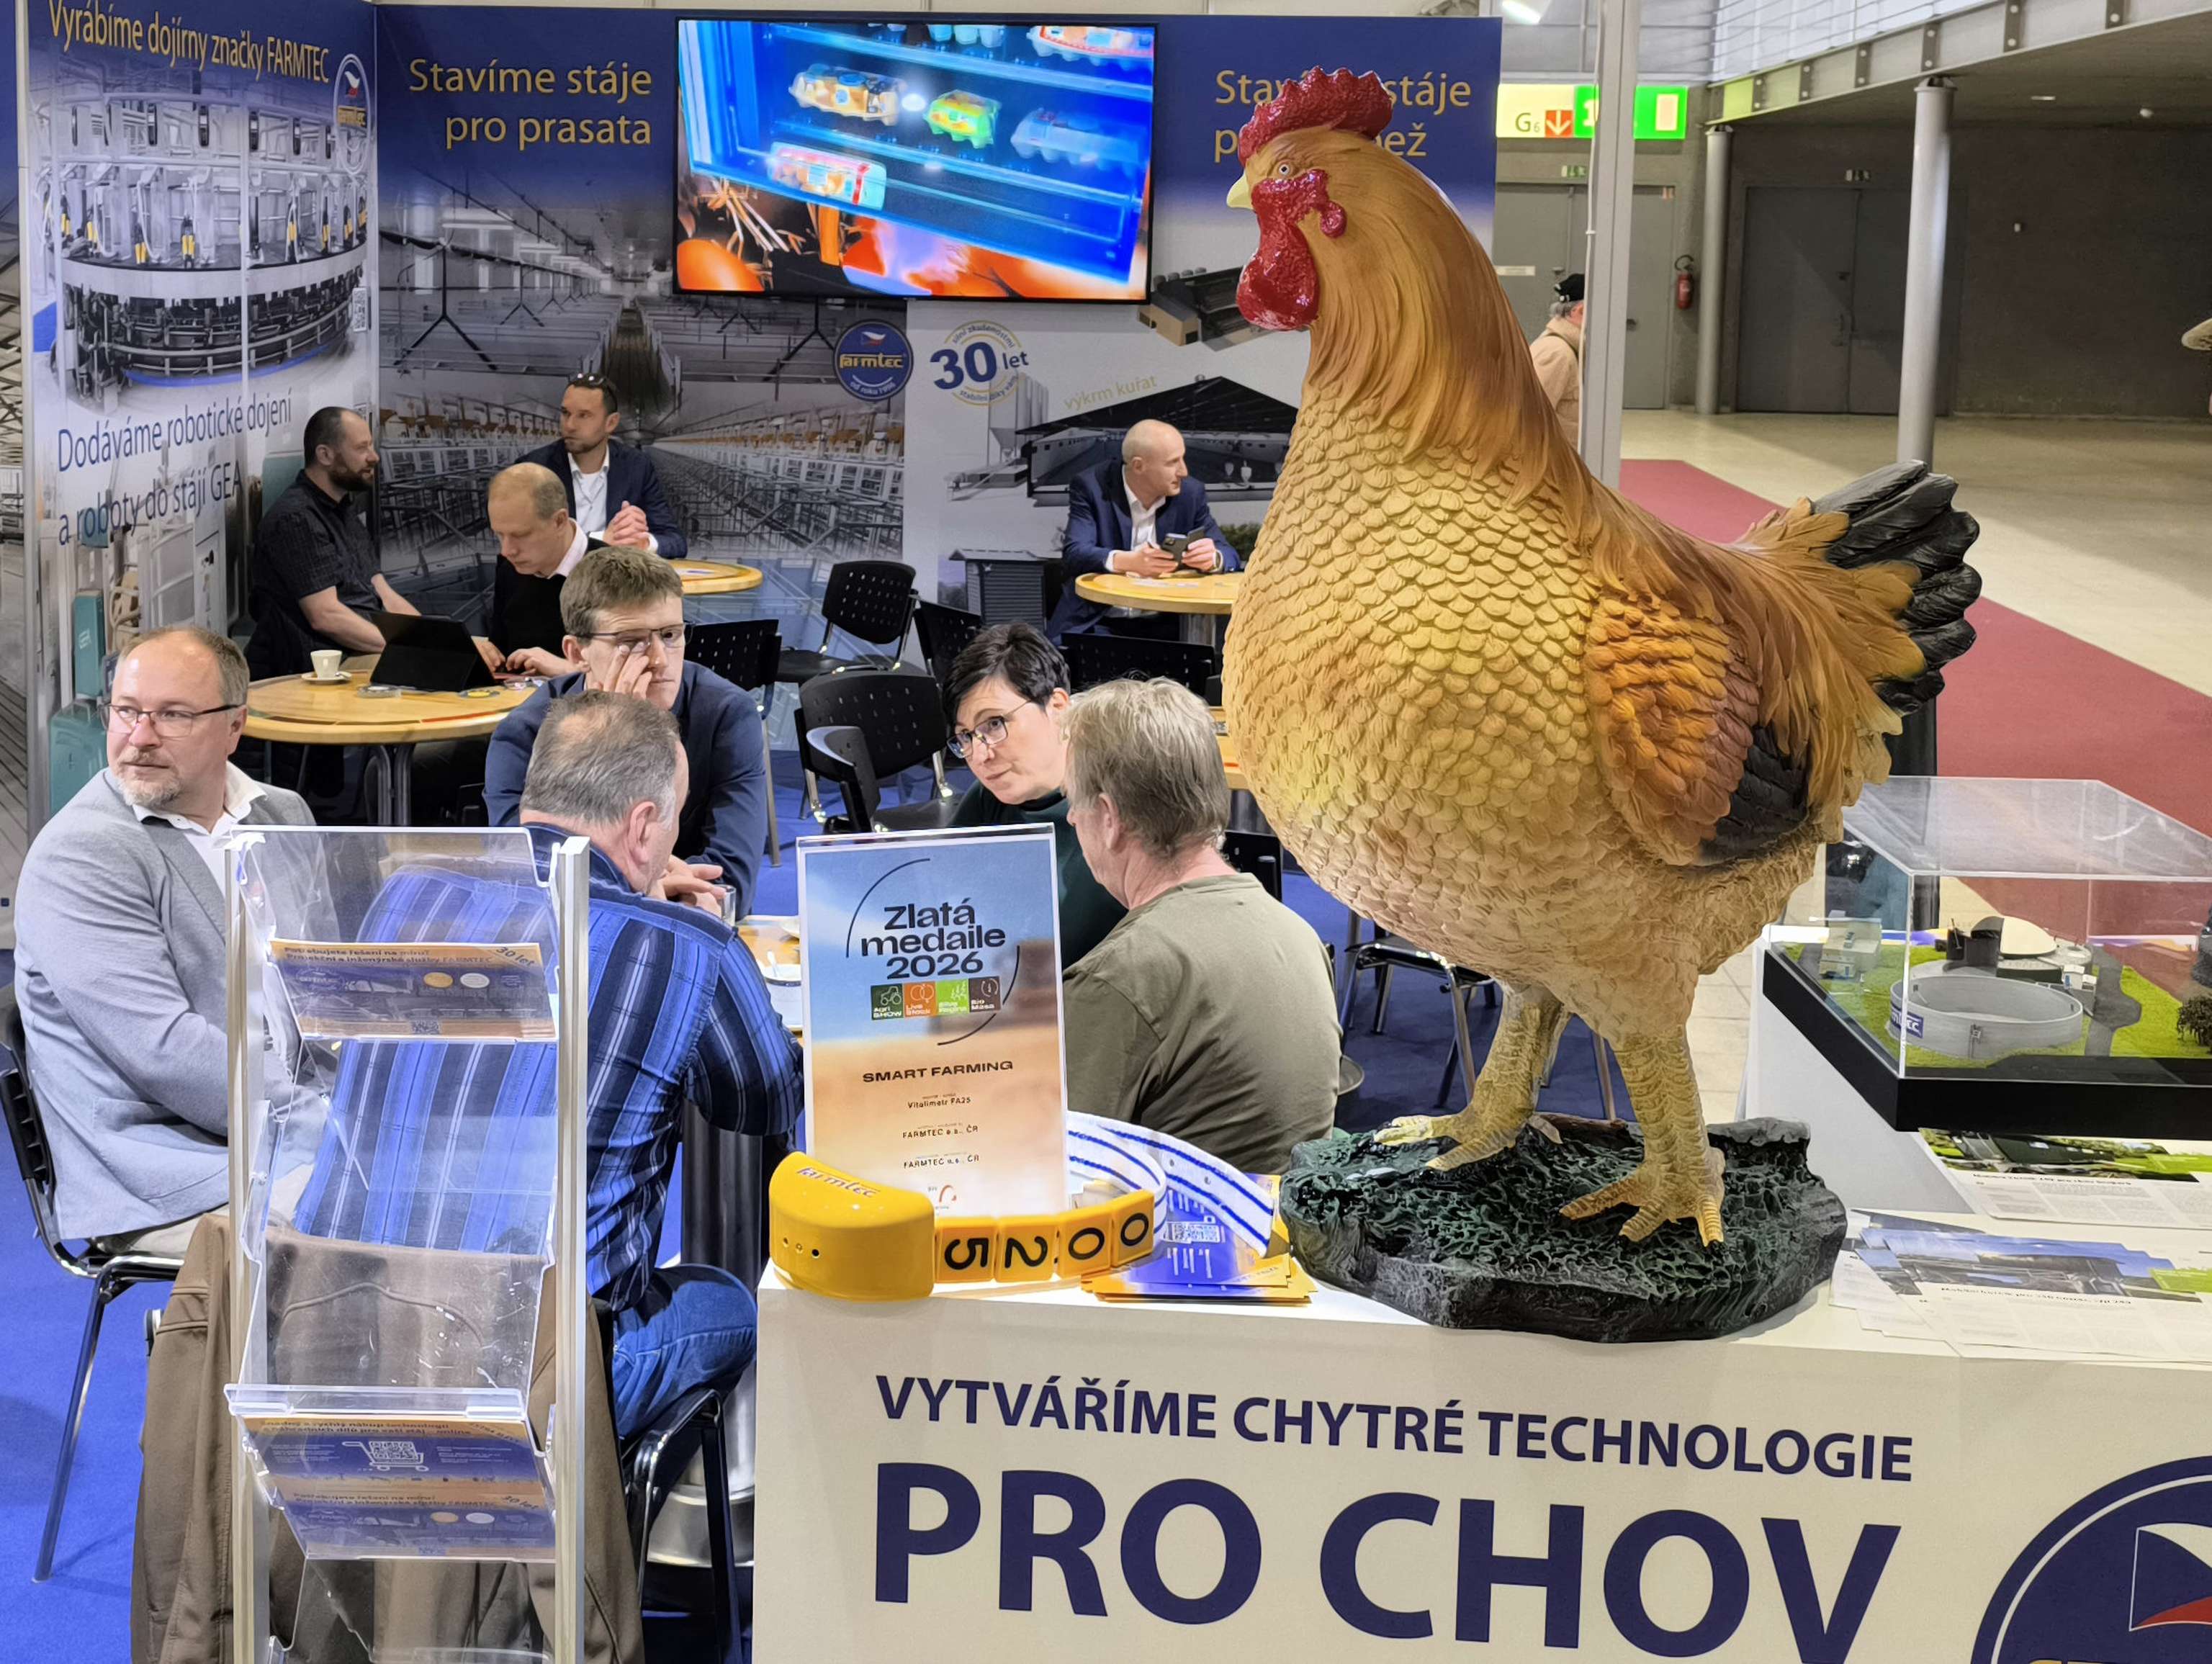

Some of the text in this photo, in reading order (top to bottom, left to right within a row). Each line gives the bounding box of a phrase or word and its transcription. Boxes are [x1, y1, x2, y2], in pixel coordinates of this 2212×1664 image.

[49, 0, 330, 84] Vyrábíme dojírny značky FARMTEC
[409, 58, 652, 104] Stavíme stáje
[446, 114, 652, 151] pro prasata
[840, 352, 904, 369] farmtec
[930, 342, 1029, 390] 30 let
[1064, 387, 1113, 411] výkrm
[58, 387, 292, 472] Dodáváme robotické dojení
[58, 459, 244, 546] a roboty do stájí GEA
[884, 897, 976, 931] Zlatá
[495, 945, 535, 967] 30 let
[860, 925, 1006, 957] medaile
[886, 952, 984, 980] 2026
[862, 1061, 1014, 1083] SMART FARMING
[907, 1099, 948, 1110] Vitalimetr
[902, 1128, 943, 1139] FARMTEC
[966, 1124, 979, 1134] ČR
[904, 1158, 945, 1169] FARMTEC
[796, 1167, 881, 1198] farmtec
[876, 1375, 1913, 1482] VYTVÁŘÍME CHYTRÉ TECHNOLOGIE
[874, 1462, 1902, 1664] PRO CHOV
